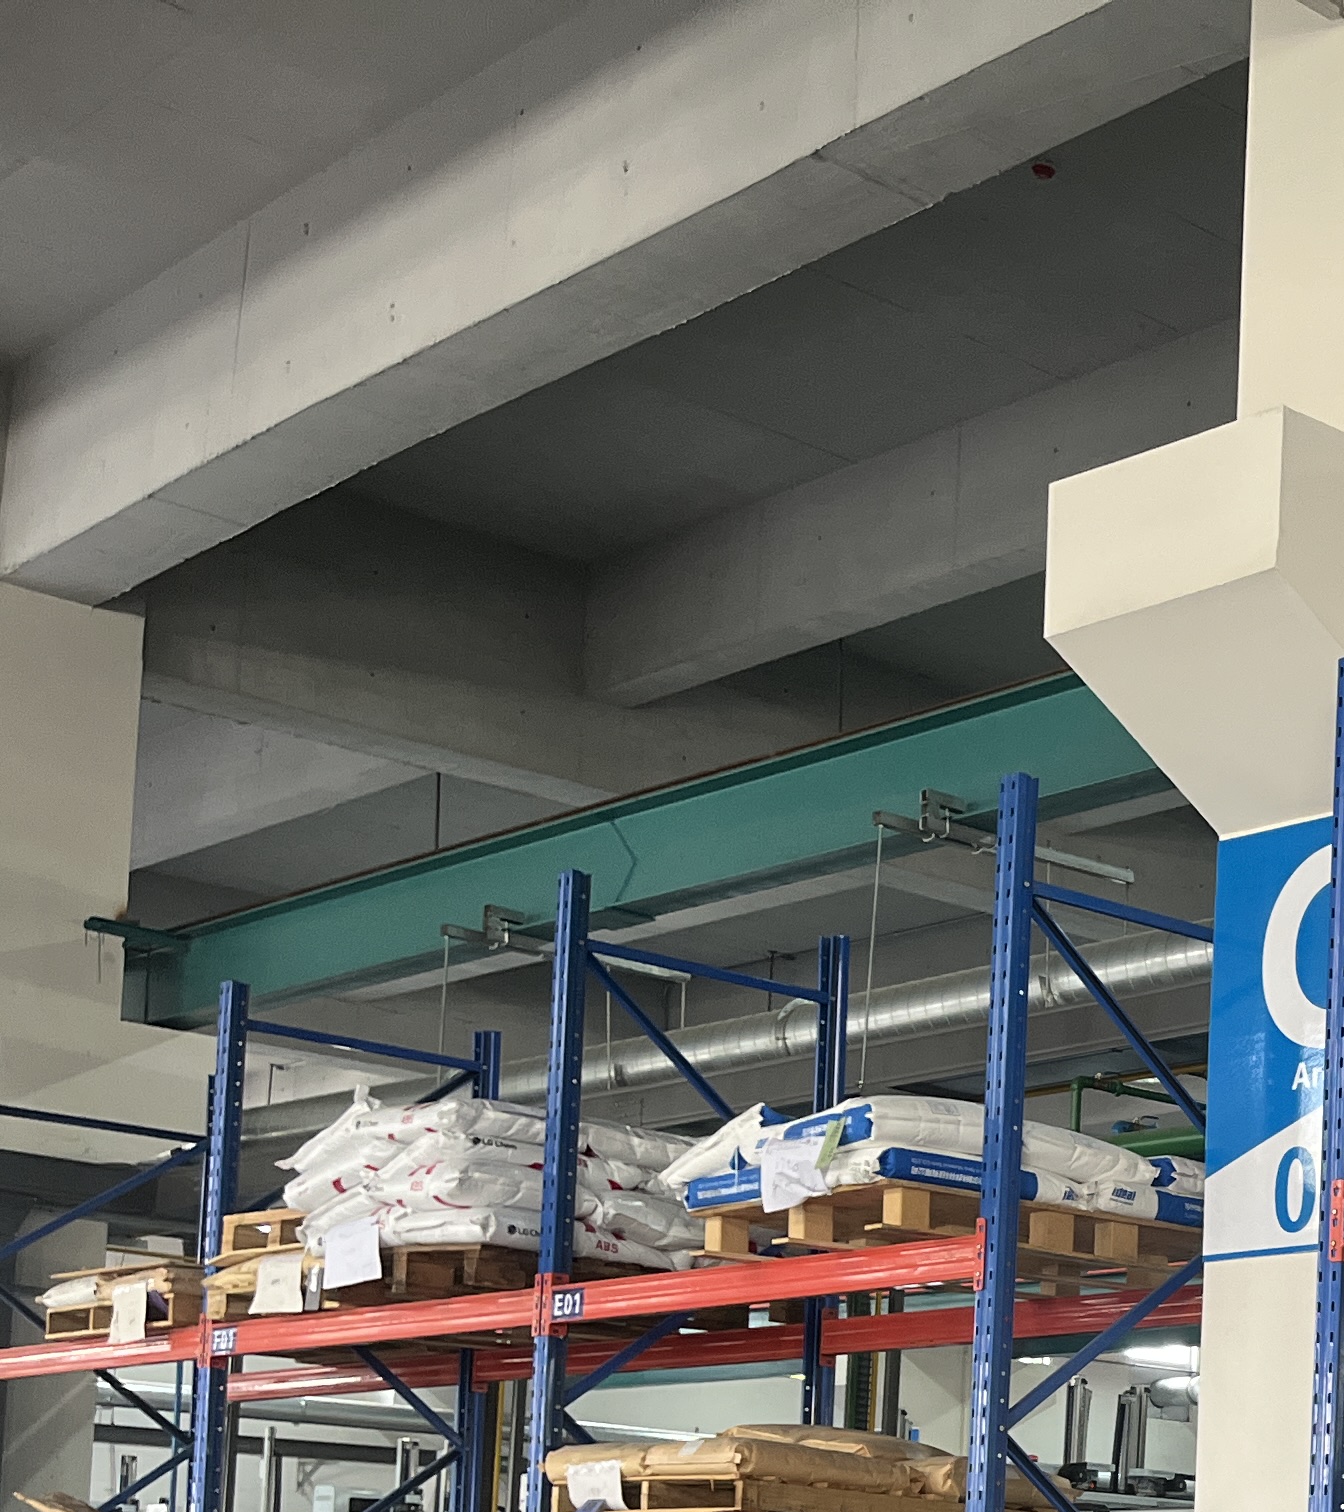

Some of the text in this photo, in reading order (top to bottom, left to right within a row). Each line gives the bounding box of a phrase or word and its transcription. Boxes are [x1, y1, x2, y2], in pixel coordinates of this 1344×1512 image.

[1291, 1062, 1324, 1090] Ar
[595, 1239, 620, 1255] ABS
[553, 1291, 582, 1317] E01
